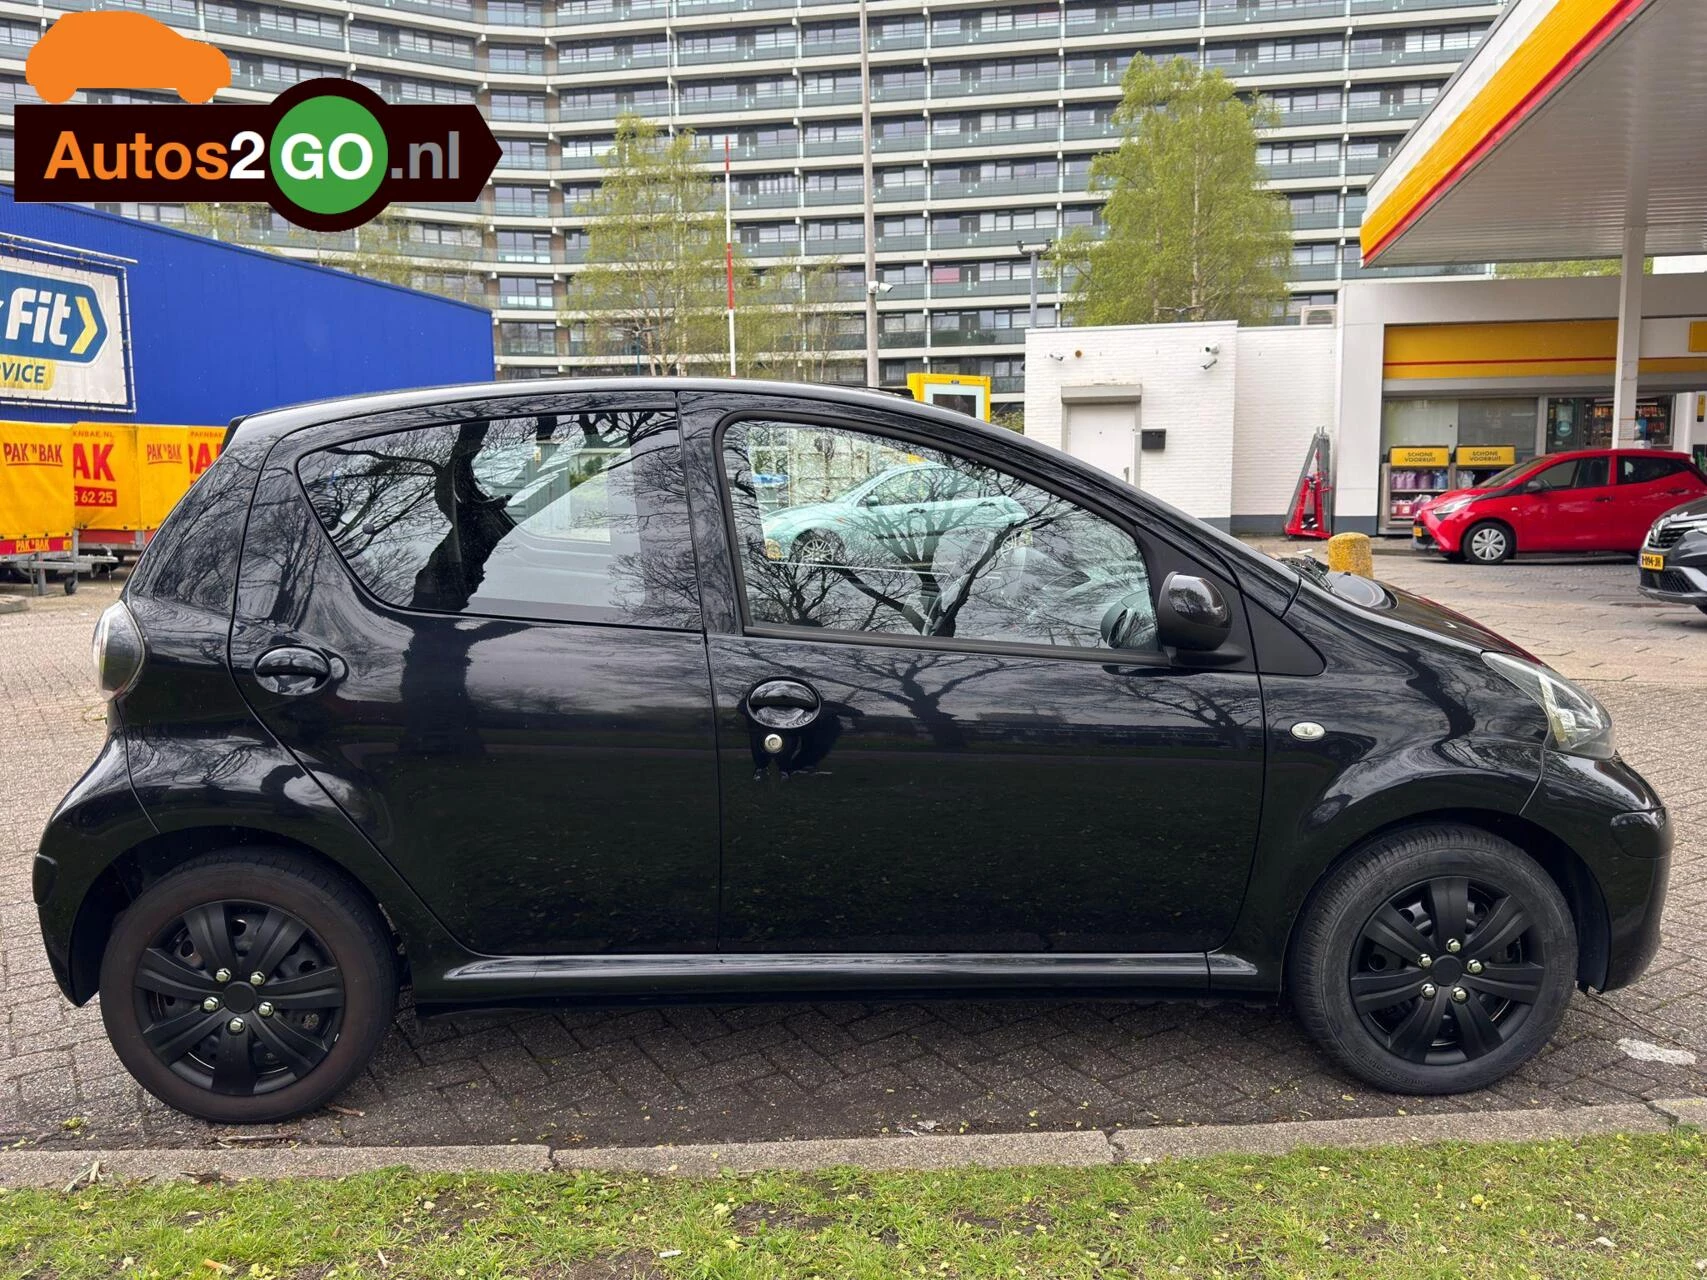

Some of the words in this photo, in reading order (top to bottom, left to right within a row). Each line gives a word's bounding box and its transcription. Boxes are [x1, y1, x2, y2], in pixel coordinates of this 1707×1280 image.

[5, 287, 71, 347] Fit
[0, 362, 46, 384] VICE
[4, 443, 29, 462] PAK
[38, 444, 63, 463] BAK
[147, 443, 162, 461] PAK
[168, 444, 182, 461] BAK
[81, 491, 96, 503] 62
[98, 492, 114, 504] 25
